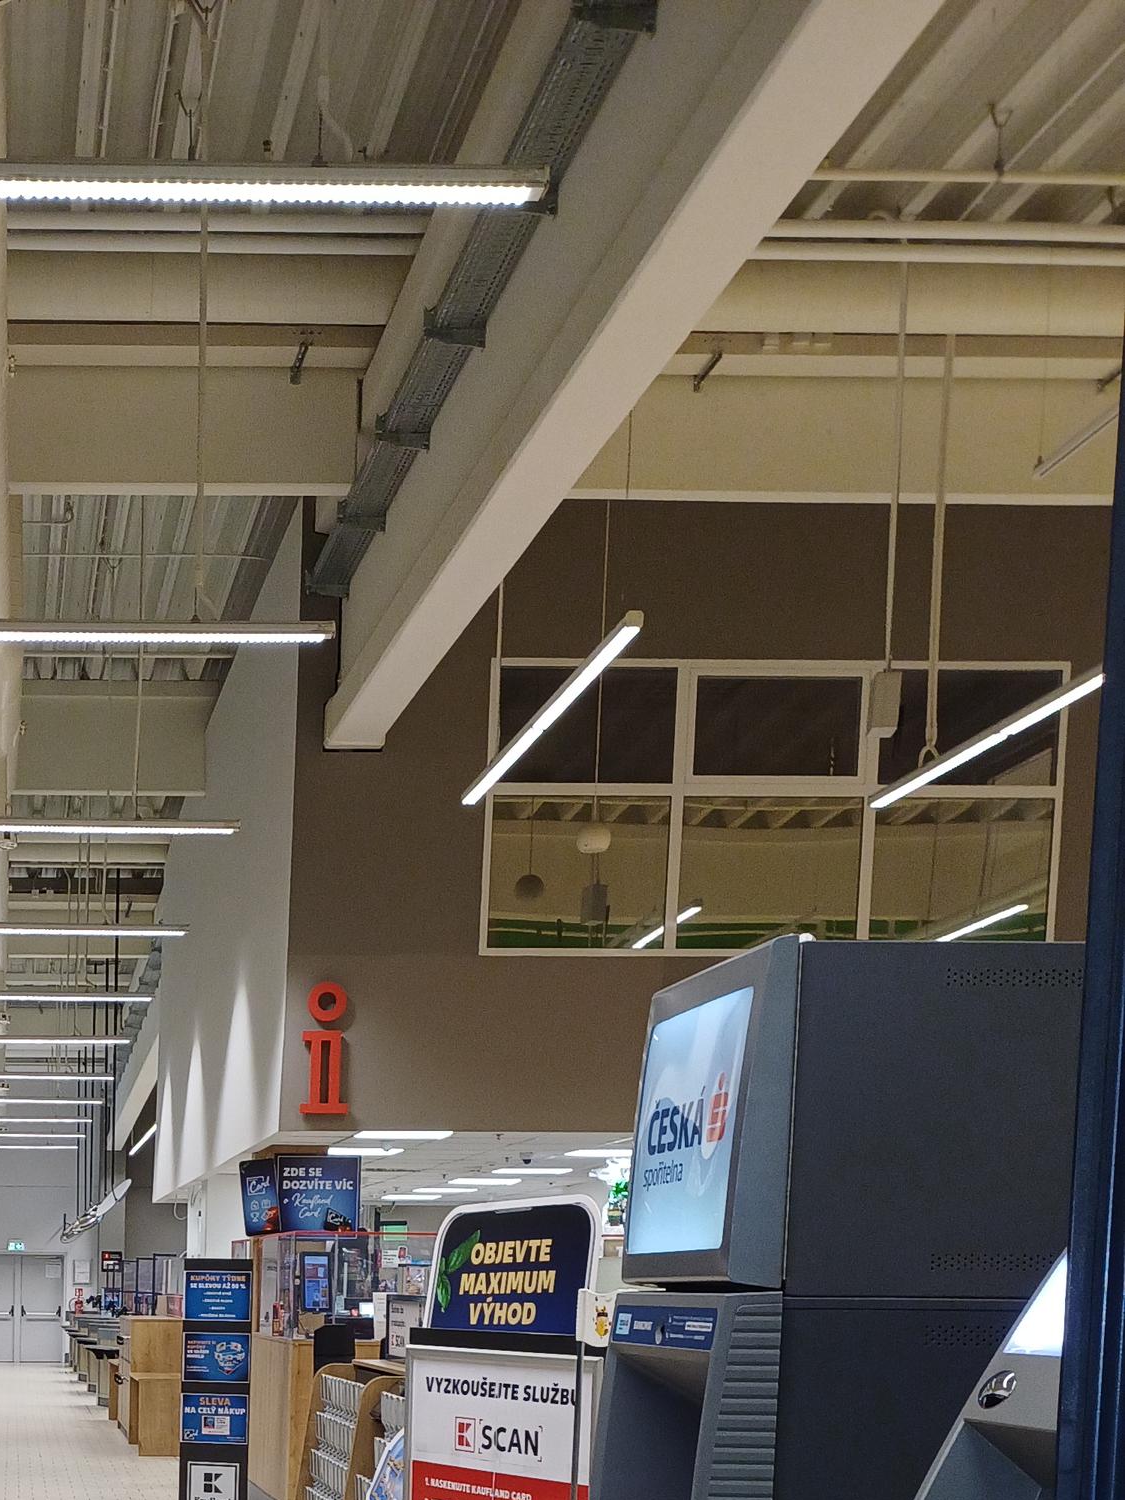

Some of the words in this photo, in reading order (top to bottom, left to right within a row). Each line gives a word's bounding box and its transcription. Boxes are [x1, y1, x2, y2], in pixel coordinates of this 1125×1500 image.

[647, 1085, 706, 1156] ČESKÁ
[282, 1178, 332, 1190] DOZVÍTE
[334, 1178, 354, 1190] VÍC
[283, 1167, 306, 1177] ZDE
[308, 1167, 323, 1177] SE
[642, 1160, 683, 1192] spořitelna
[249, 1176, 271, 1194] Card
[470, 1238, 553, 1265] OBJEVTE
[458, 1270, 557, 1295] MAXIMUM
[469, 1296, 537, 1326] VÝHOD
[425, 1376, 520, 1401] VYZKOUŠEJTE
[184, 1406, 196, 1414] NA
[198, 1406, 216, 1415] CELÝ
[217, 1406, 246, 1415] NÁKUP
[199, 1397, 231, 1406] SLEVA
[481, 1425, 539, 1457] SCAN
[471, 1484, 510, 1499] KAUFLAND
